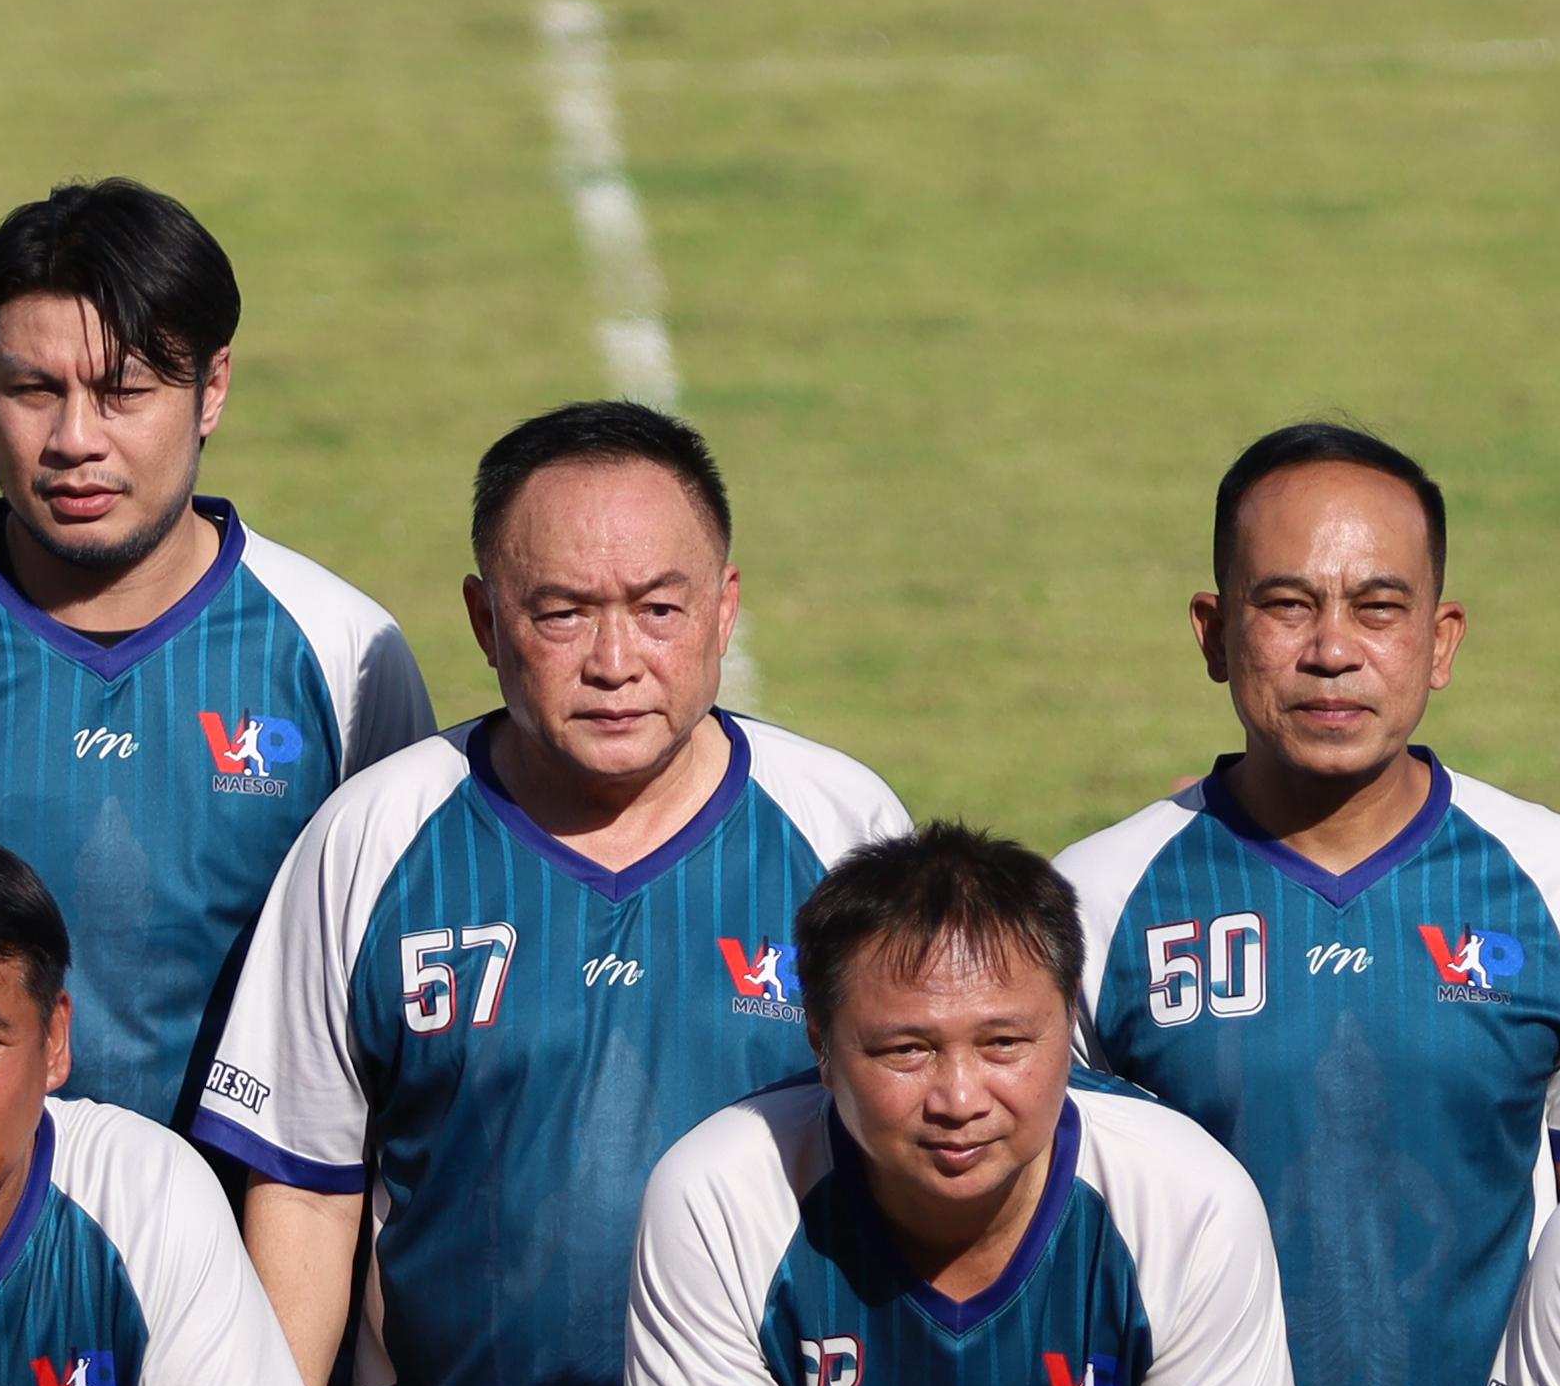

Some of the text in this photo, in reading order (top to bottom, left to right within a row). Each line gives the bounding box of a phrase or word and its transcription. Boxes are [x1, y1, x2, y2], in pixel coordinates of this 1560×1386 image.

[213, 775, 288, 797] MAESOT
[399, 921, 518, 1035] 57
[1145, 911, 1267, 1028] 50
[1438, 985, 1512, 1004] MAESOT
[732, 997, 805, 1023] MAESOT
